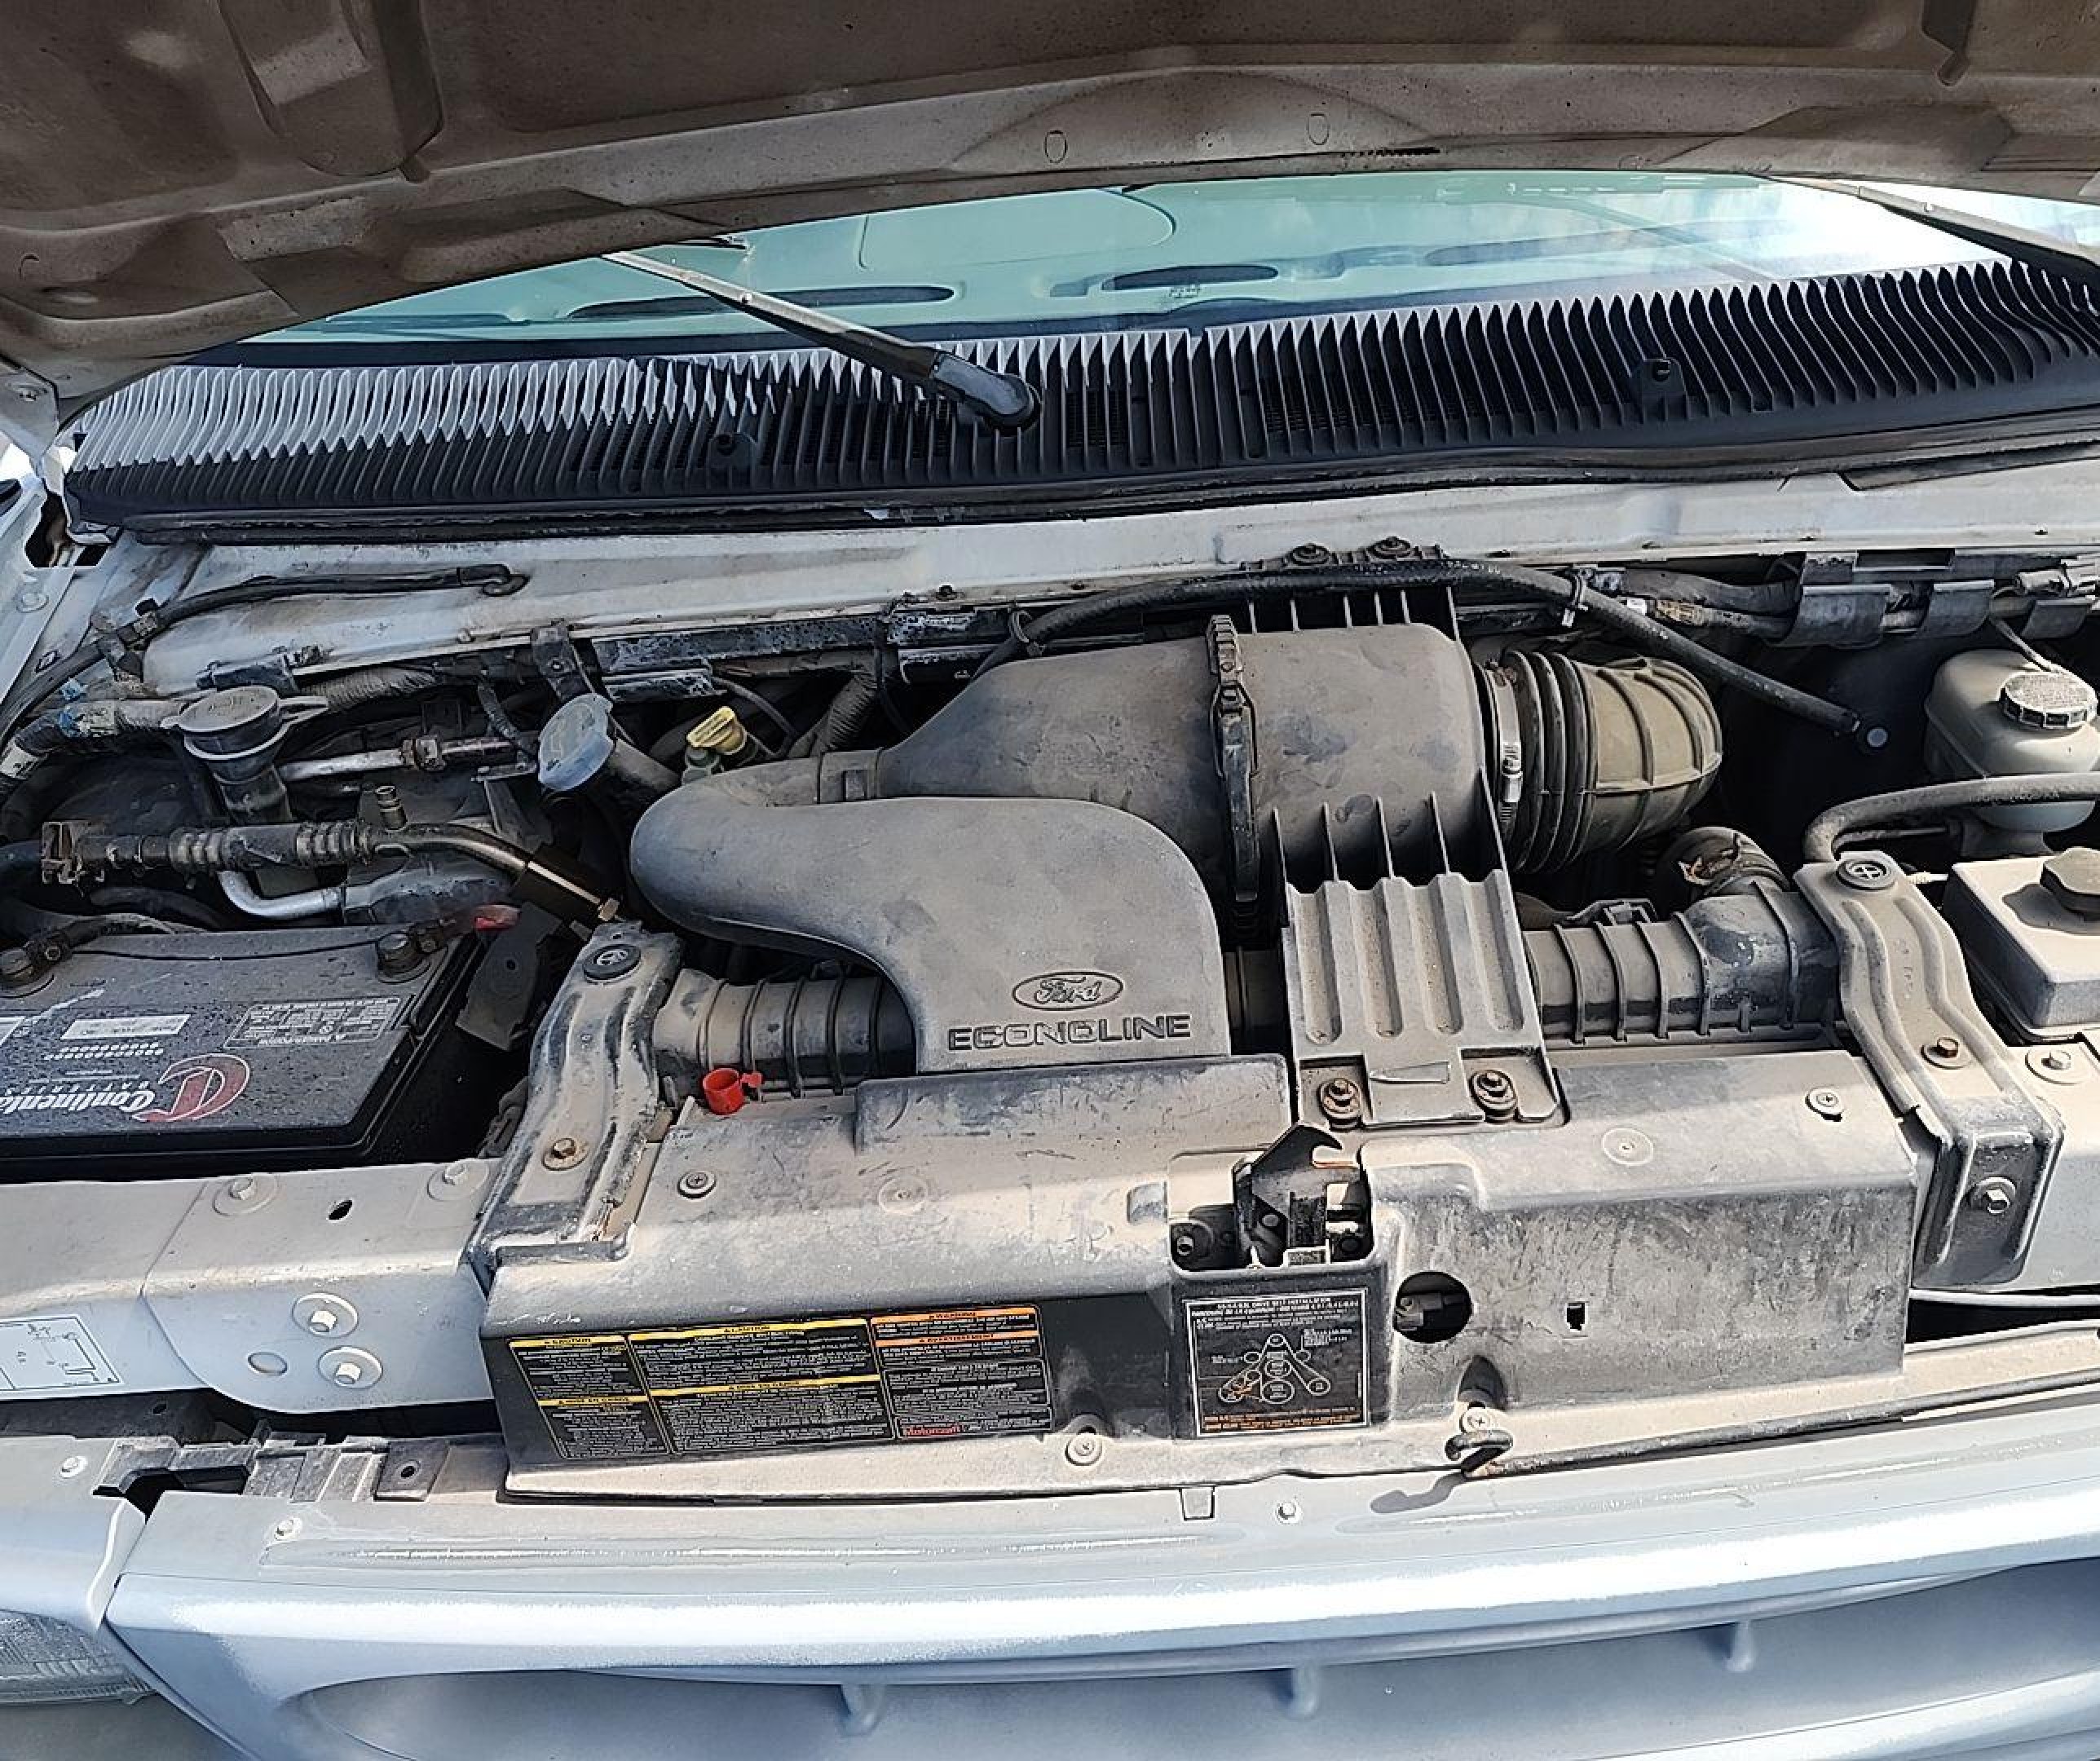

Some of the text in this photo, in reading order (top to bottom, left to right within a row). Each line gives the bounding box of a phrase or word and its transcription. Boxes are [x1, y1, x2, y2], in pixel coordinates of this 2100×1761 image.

[1034, 976, 1103, 1004] Ford
[947, 1013, 1192, 1052] ECONOLINE
[0, 1090, 156, 1115] Continenta
